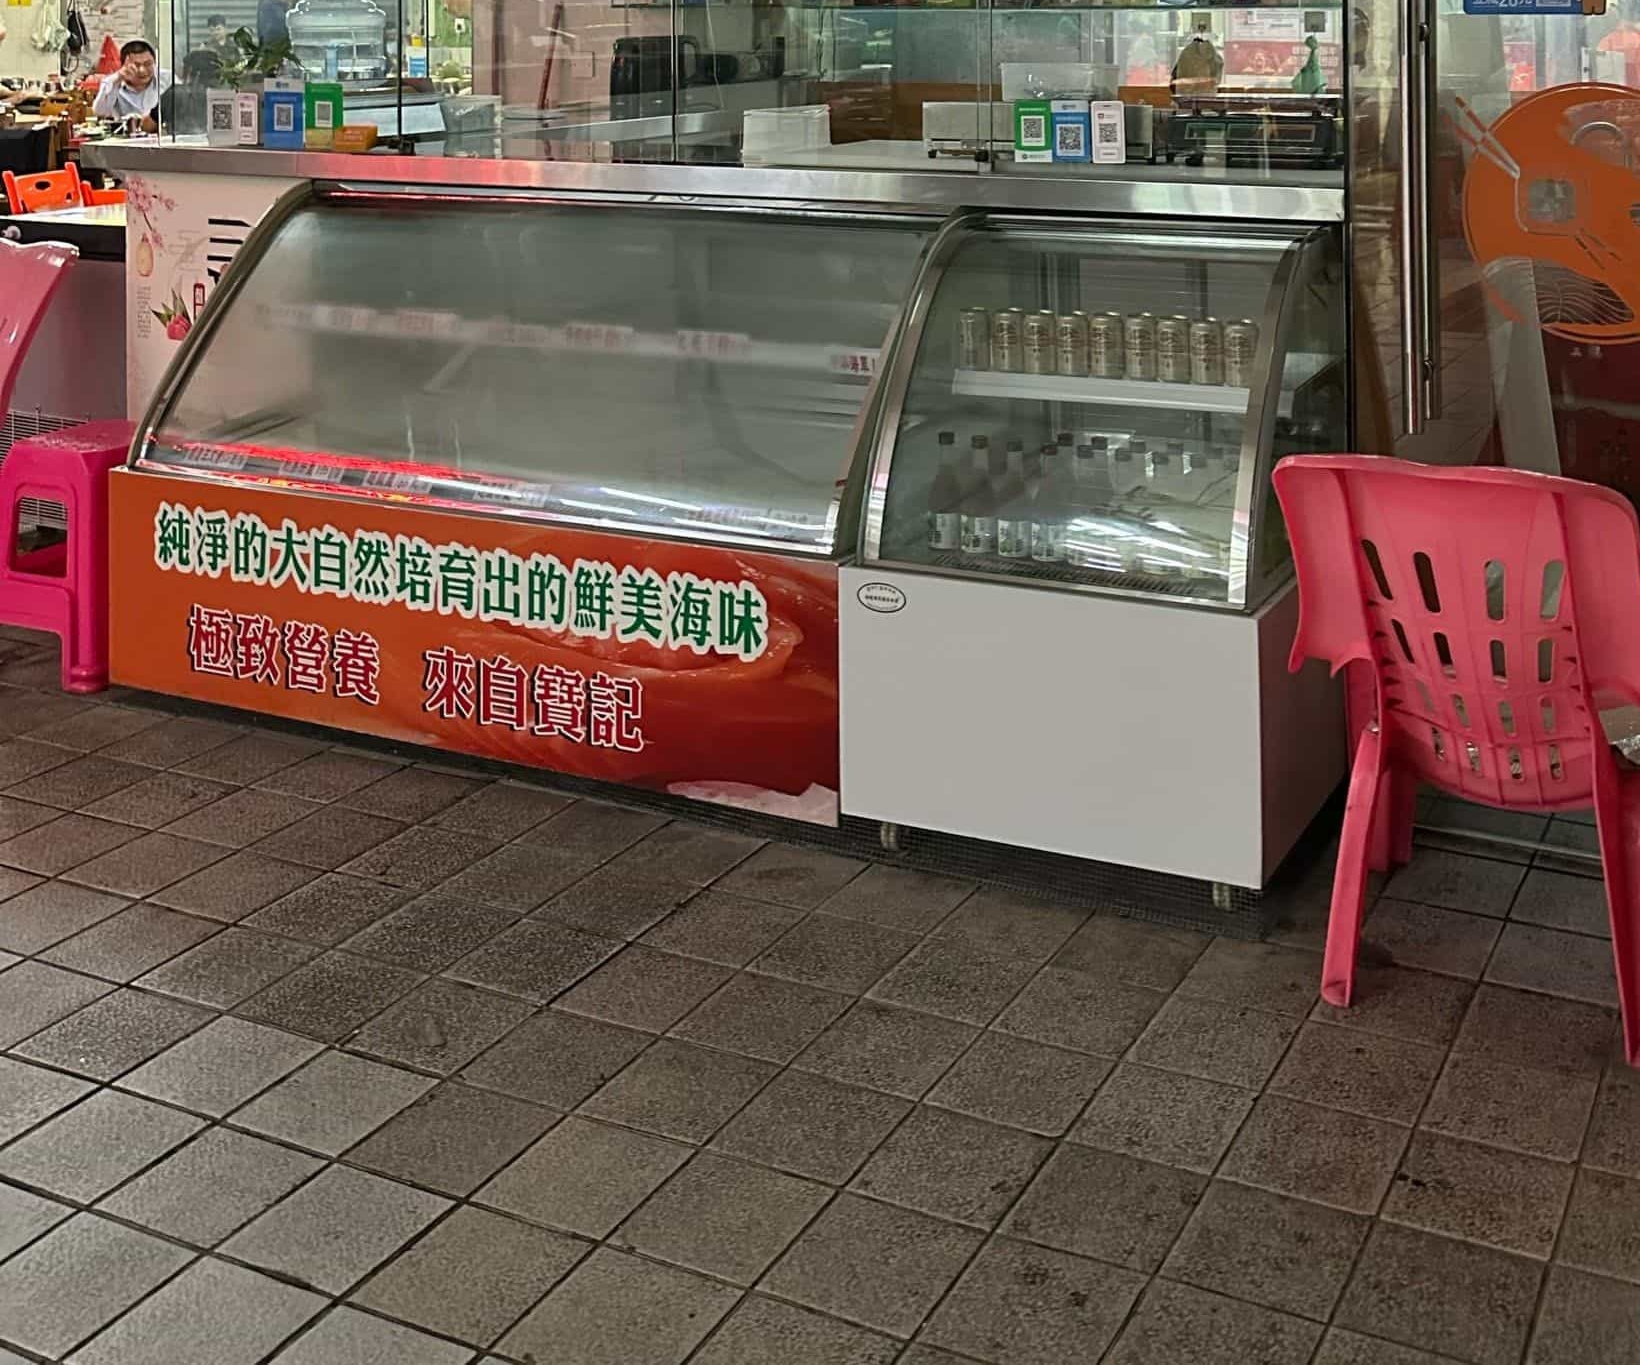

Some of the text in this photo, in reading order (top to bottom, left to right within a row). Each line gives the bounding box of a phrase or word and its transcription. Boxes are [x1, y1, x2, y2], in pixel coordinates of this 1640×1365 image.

[155, 506, 768, 657] 純淨的大自然培育出的鮮美海味
[189, 604, 645, 751] 極致營養 來自寶記
